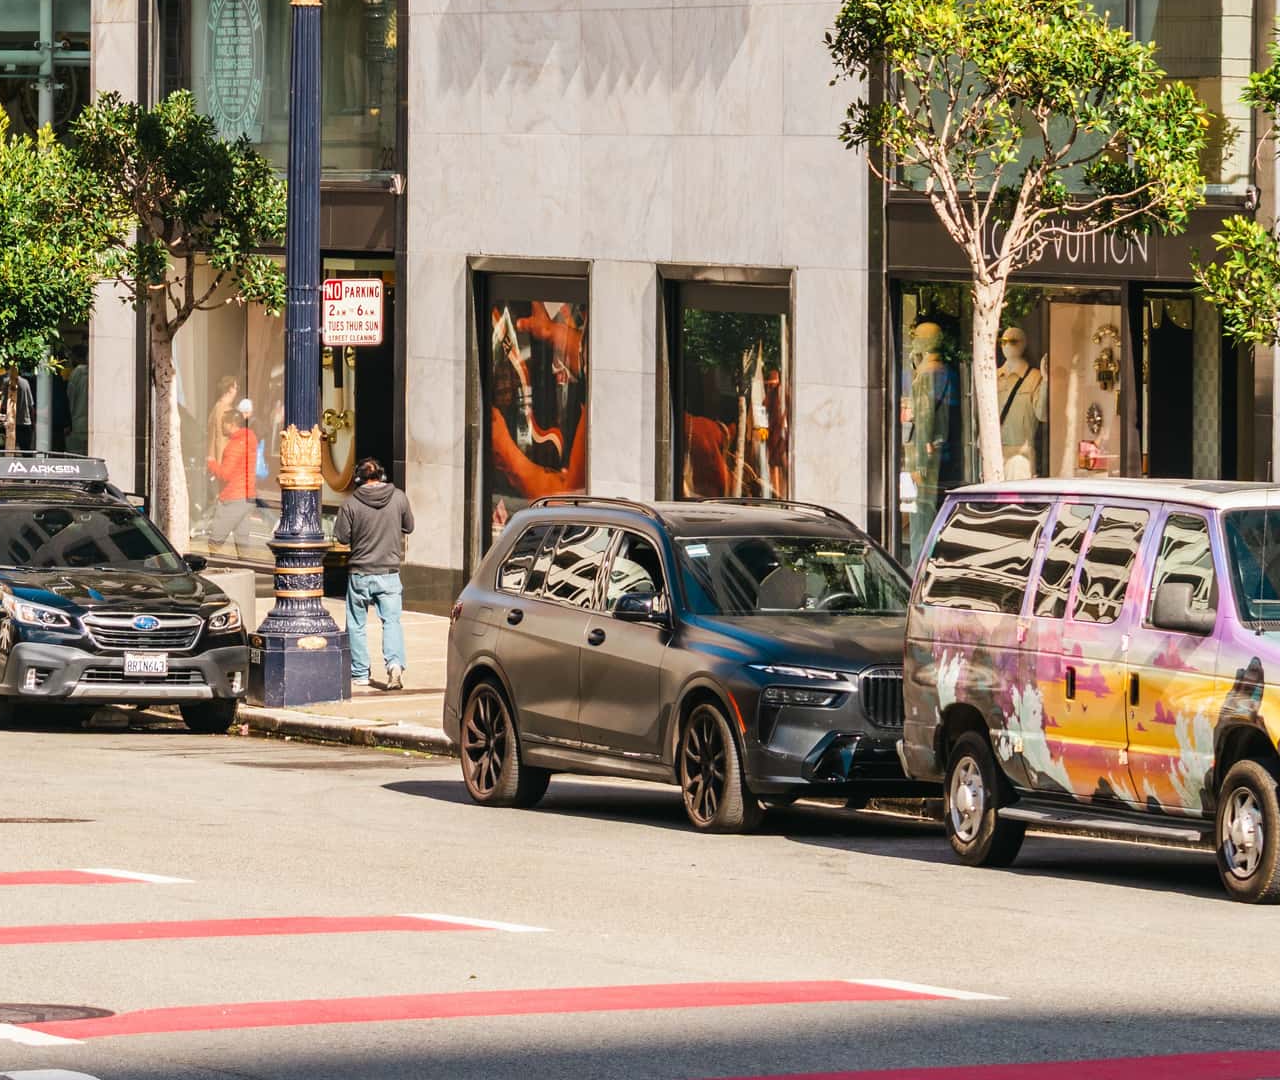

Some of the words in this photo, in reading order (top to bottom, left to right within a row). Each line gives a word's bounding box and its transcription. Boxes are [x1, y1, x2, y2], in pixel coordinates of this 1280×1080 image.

[326, 283, 342, 299] NO
[344, 286, 380, 298] PARKING
[357, 304, 364, 316] 6
[328, 321, 345, 331] TUES
[346, 321, 363, 331] THUR
[365, 321, 379, 331] SUN
[29, 465, 80, 474] ARKSEN
